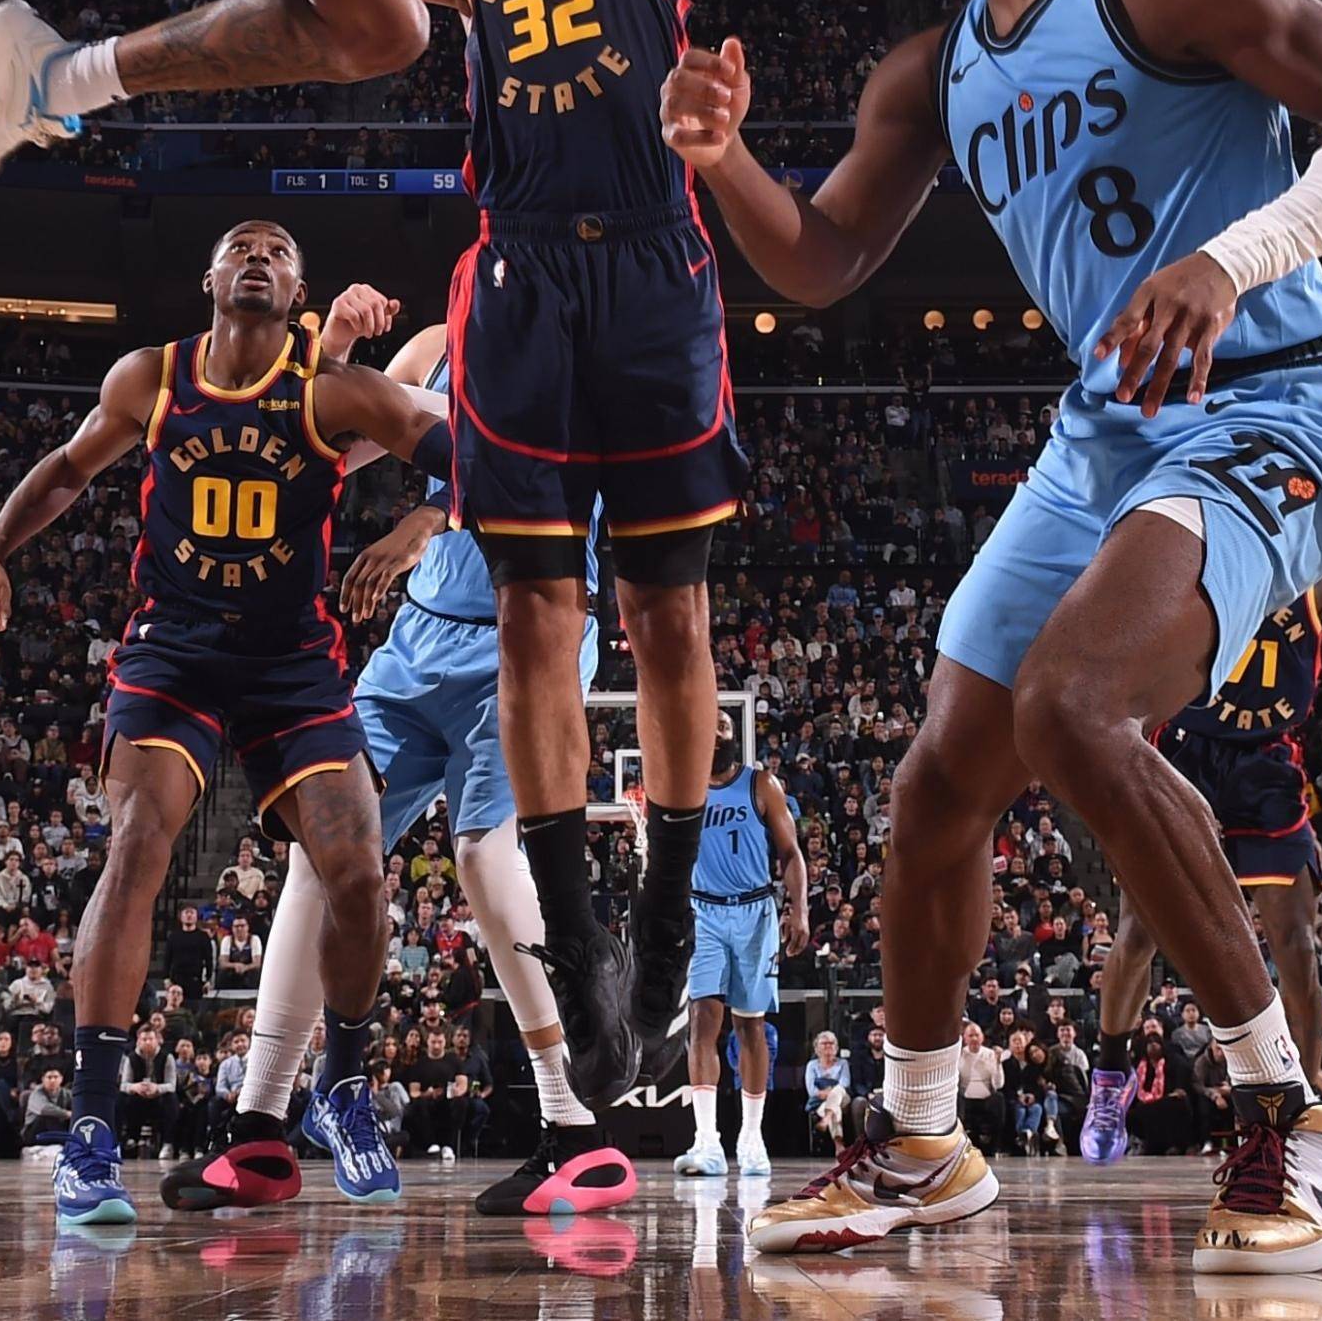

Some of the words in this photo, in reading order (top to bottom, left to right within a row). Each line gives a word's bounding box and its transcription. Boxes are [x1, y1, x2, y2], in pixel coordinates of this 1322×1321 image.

[497, 45, 631, 114] STATE
[968, 68, 1127, 216] Clips
[319, 174, 326, 189] 1
[378, 173, 388, 189] 5
[433, 173, 455, 189] 59
[1078, 166, 1155, 257] 8
[258, 398, 300, 411] Rakuten
[169, 425, 306, 481] GOLDEN
[192, 476, 278, 540] 00
[174, 538, 294, 587] STATE
[1215, 695, 1295, 730] TATE
[704, 803, 747, 829] lips
[727, 829, 739, 855] 1
